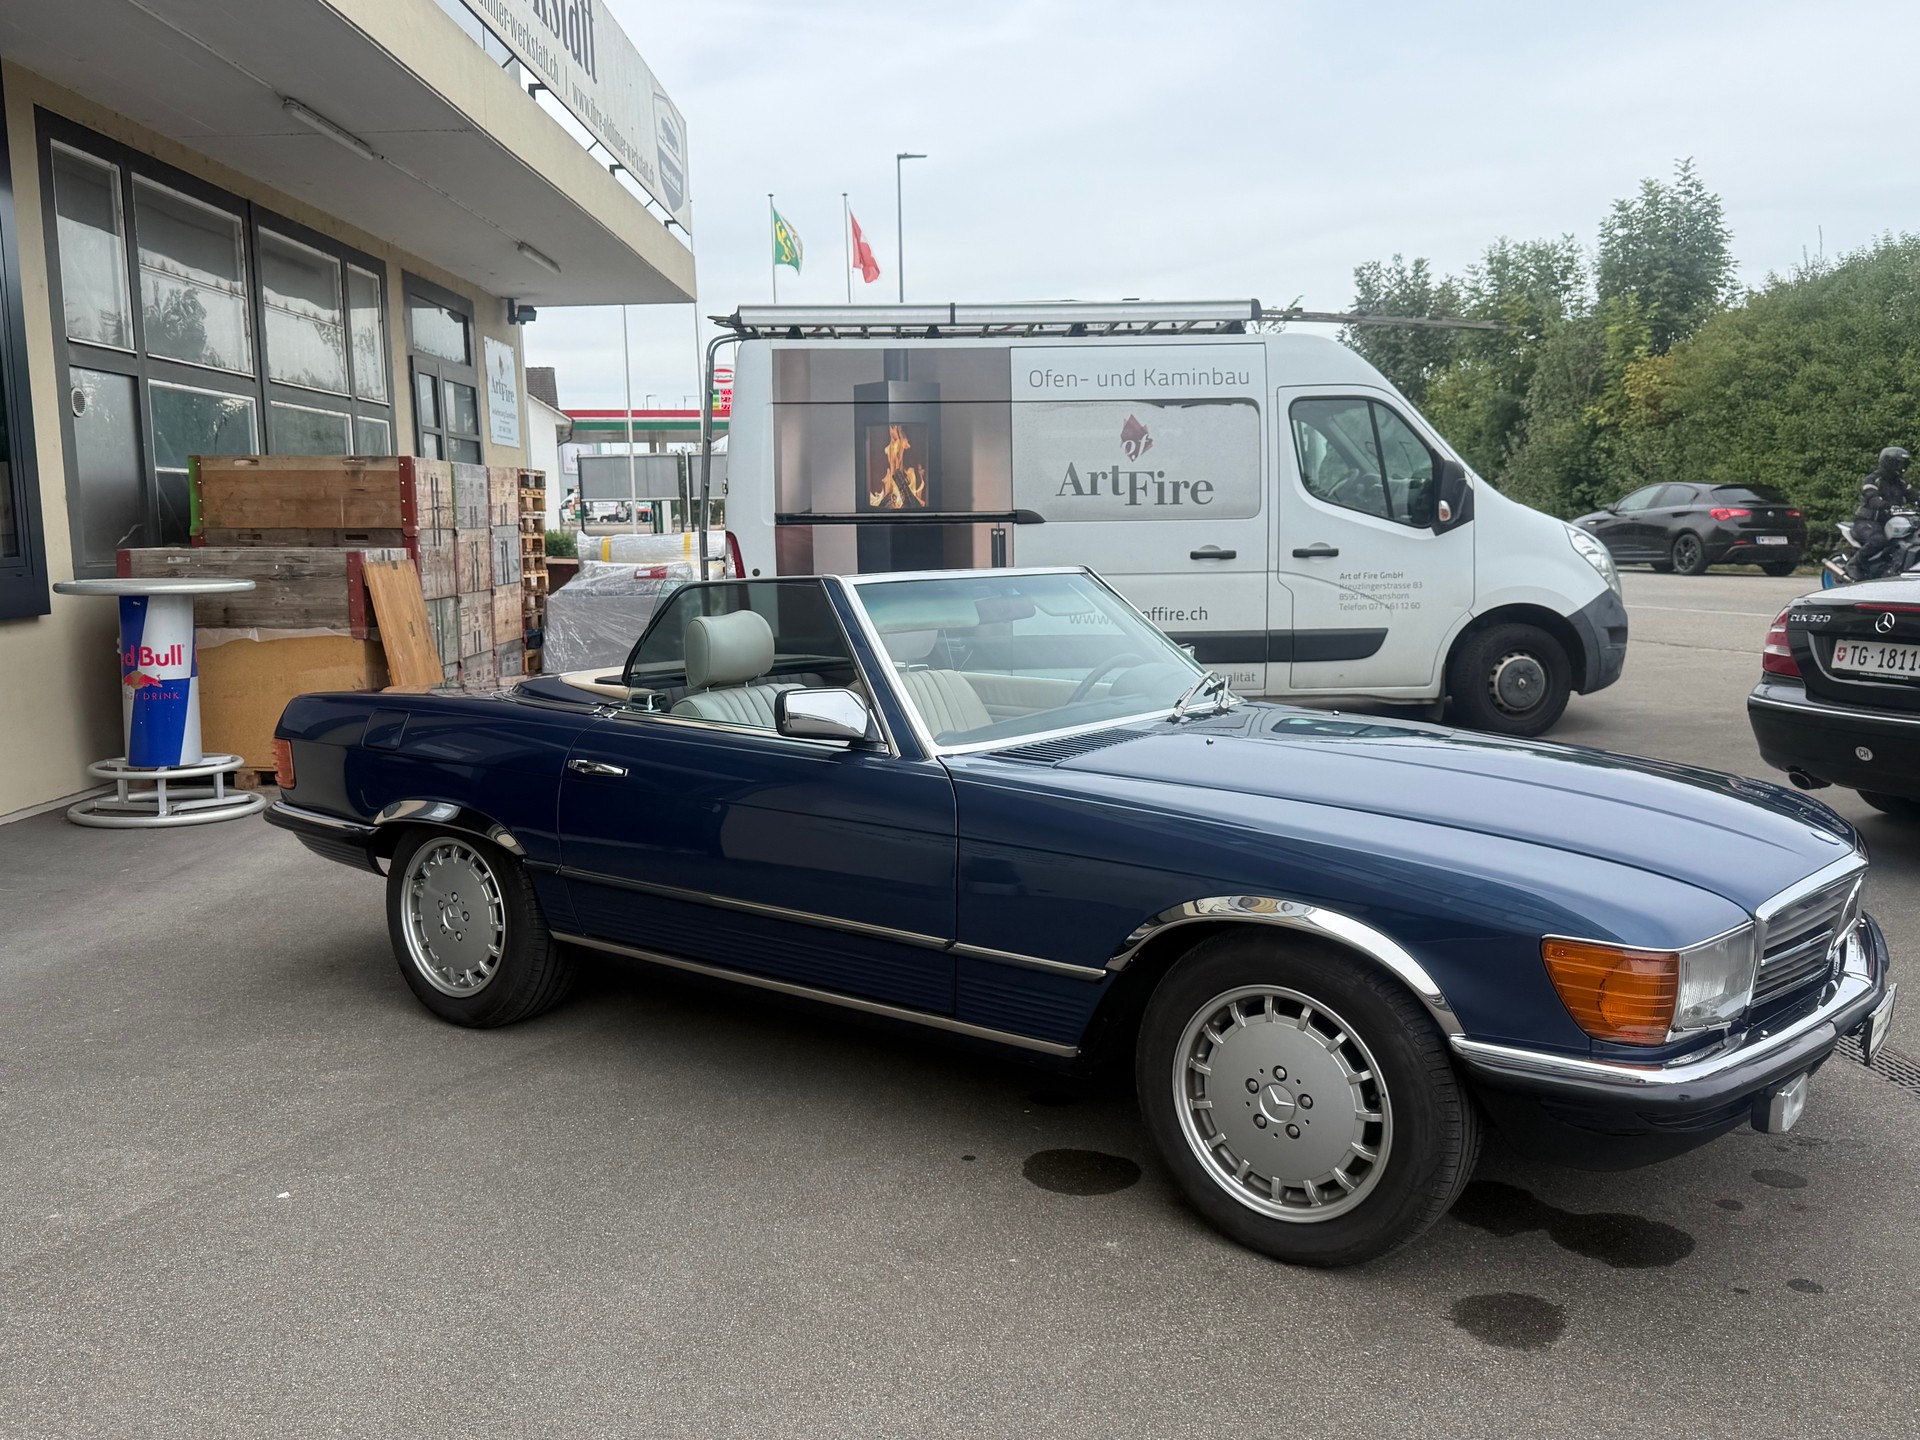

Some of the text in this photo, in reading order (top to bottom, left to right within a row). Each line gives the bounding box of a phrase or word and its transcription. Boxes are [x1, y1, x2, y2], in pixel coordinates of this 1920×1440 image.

[1029, 367, 1250, 388] Ofen- und Kaminbau
[1055, 461, 1215, 506] ArtFire
[1339, 571, 1404, 581] Art of Fire GmbH
[1339, 581, 1411, 592] Kreuzlingerstrasse
[1339, 592, 1410, 601] 8590 Romanshorn
[1339, 602, 1368, 611] Telefon
[1369, 602, 1383, 610] 071
[1400, 602, 1409, 610] 12
[1411, 602, 1421, 610] 60
[1789, 614, 1831, 623] CLK 320
[138, 644, 182, 667] Bull
[143, 691, 180, 701] DRINK
[1858, 749, 1870, 759] CH
